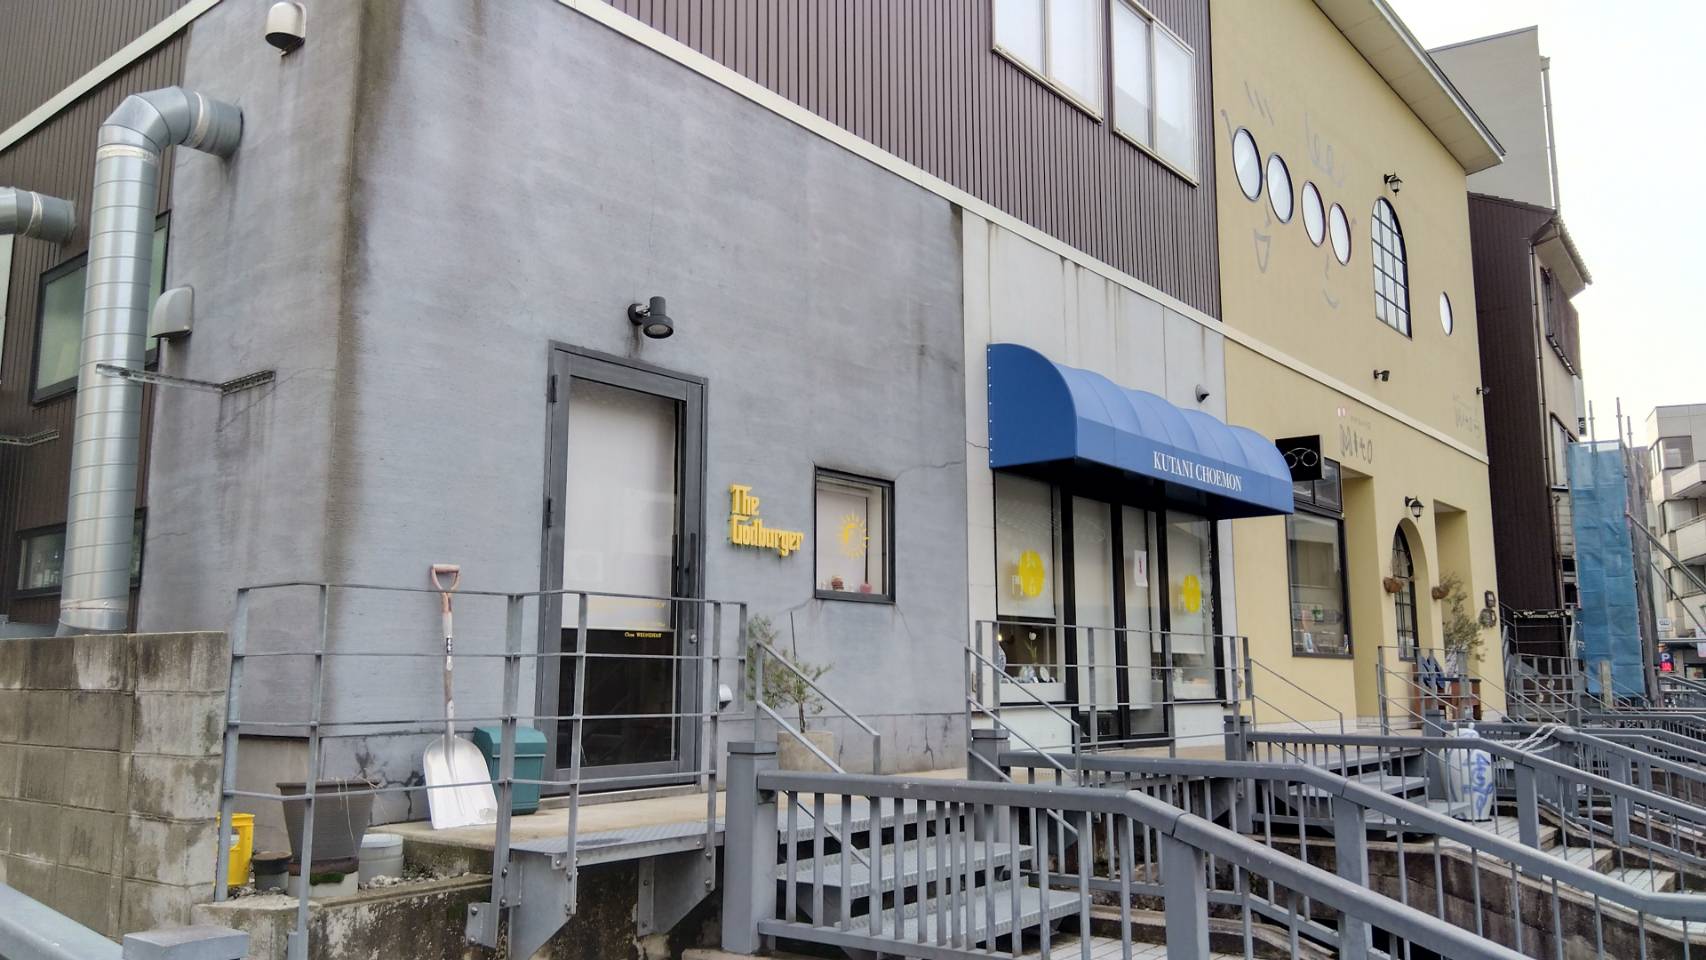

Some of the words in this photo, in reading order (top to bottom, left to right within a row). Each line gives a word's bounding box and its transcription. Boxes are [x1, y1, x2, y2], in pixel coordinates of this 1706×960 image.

[1152, 450, 1194, 479] KUTANI
[1195, 463, 1243, 492] CHOEMON
[729, 484, 760, 516] The
[730, 514, 804, 557] Godburger
[1661, 652, 1671, 662] P
